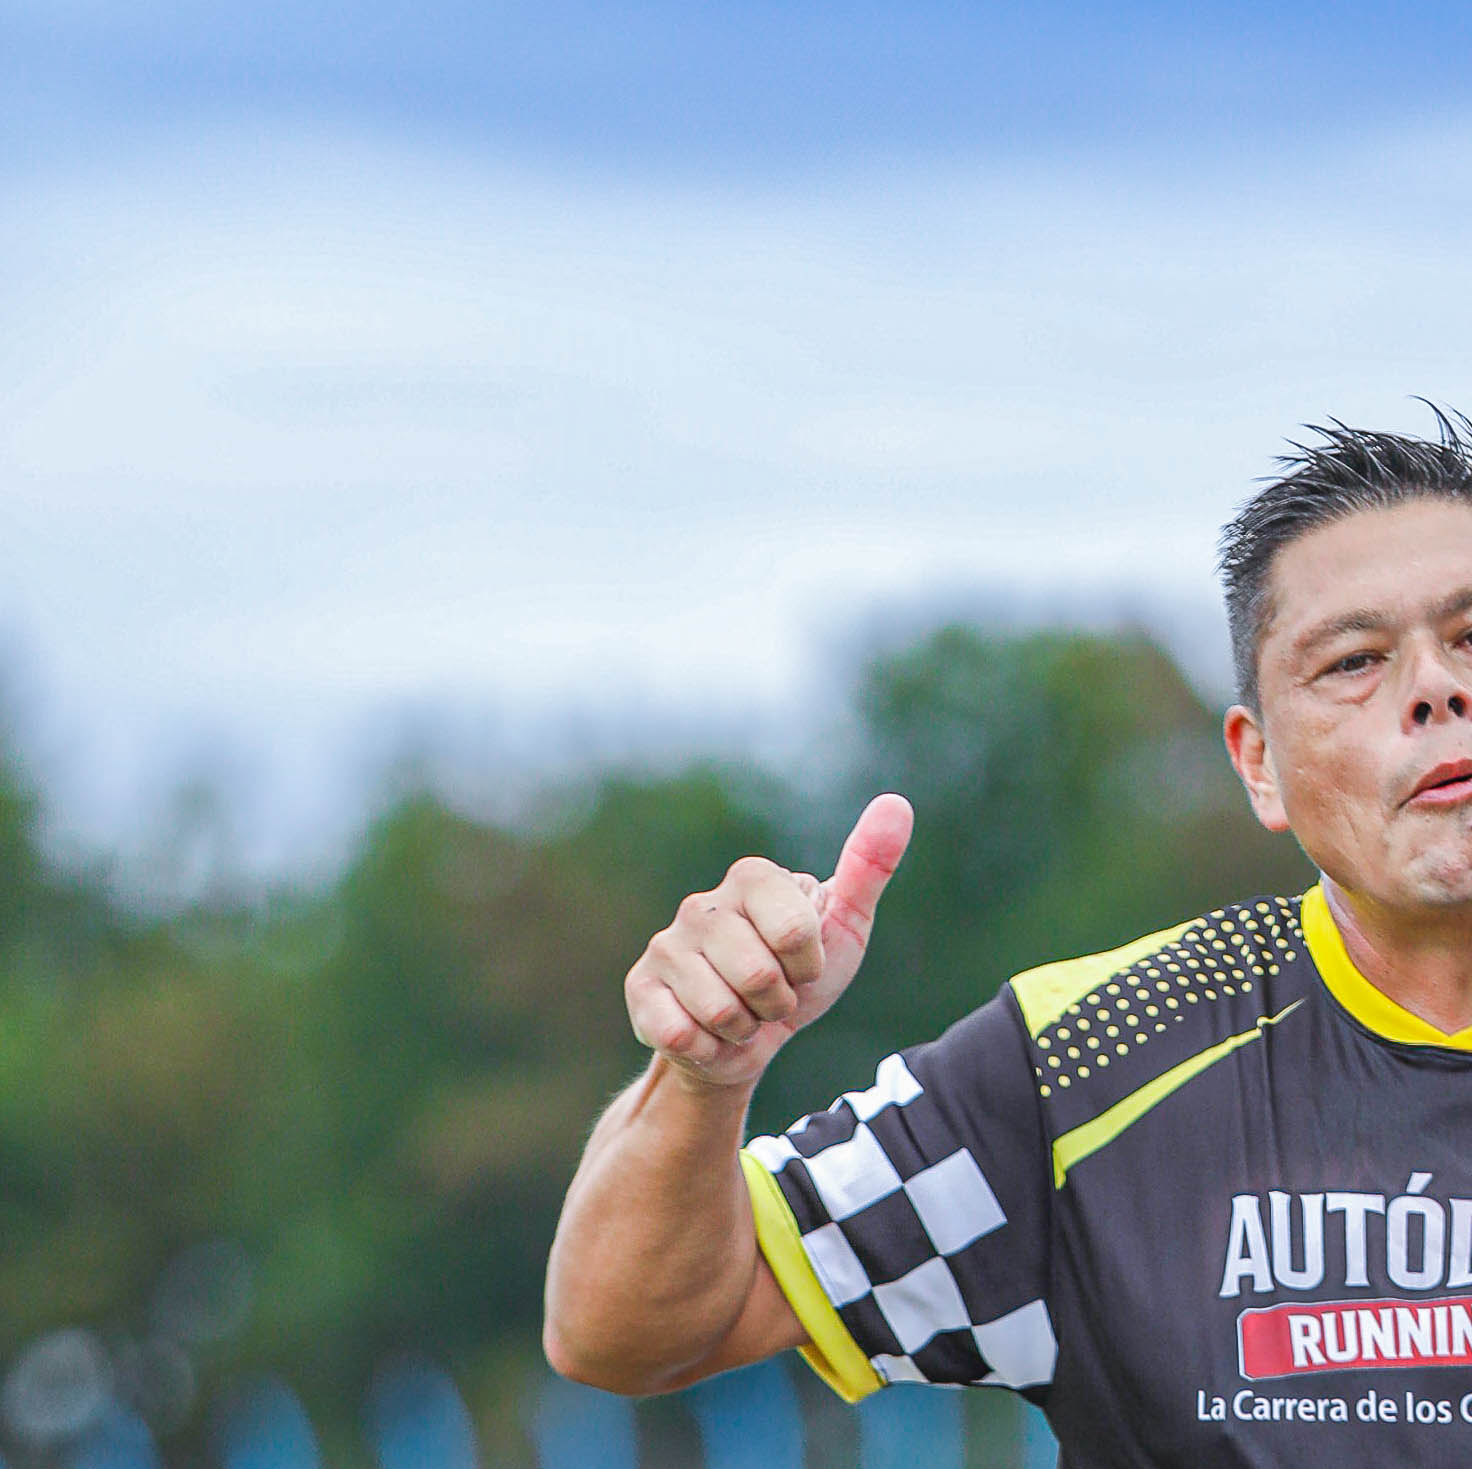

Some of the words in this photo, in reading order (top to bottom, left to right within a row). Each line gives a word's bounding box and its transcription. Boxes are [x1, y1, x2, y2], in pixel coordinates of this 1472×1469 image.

[1197, 1390, 1227, 1422] La
[1232, 1390, 1349, 1423] Carrera
[1355, 1390, 1399, 1423] de
[1406, 1391, 1453, 1425] los
